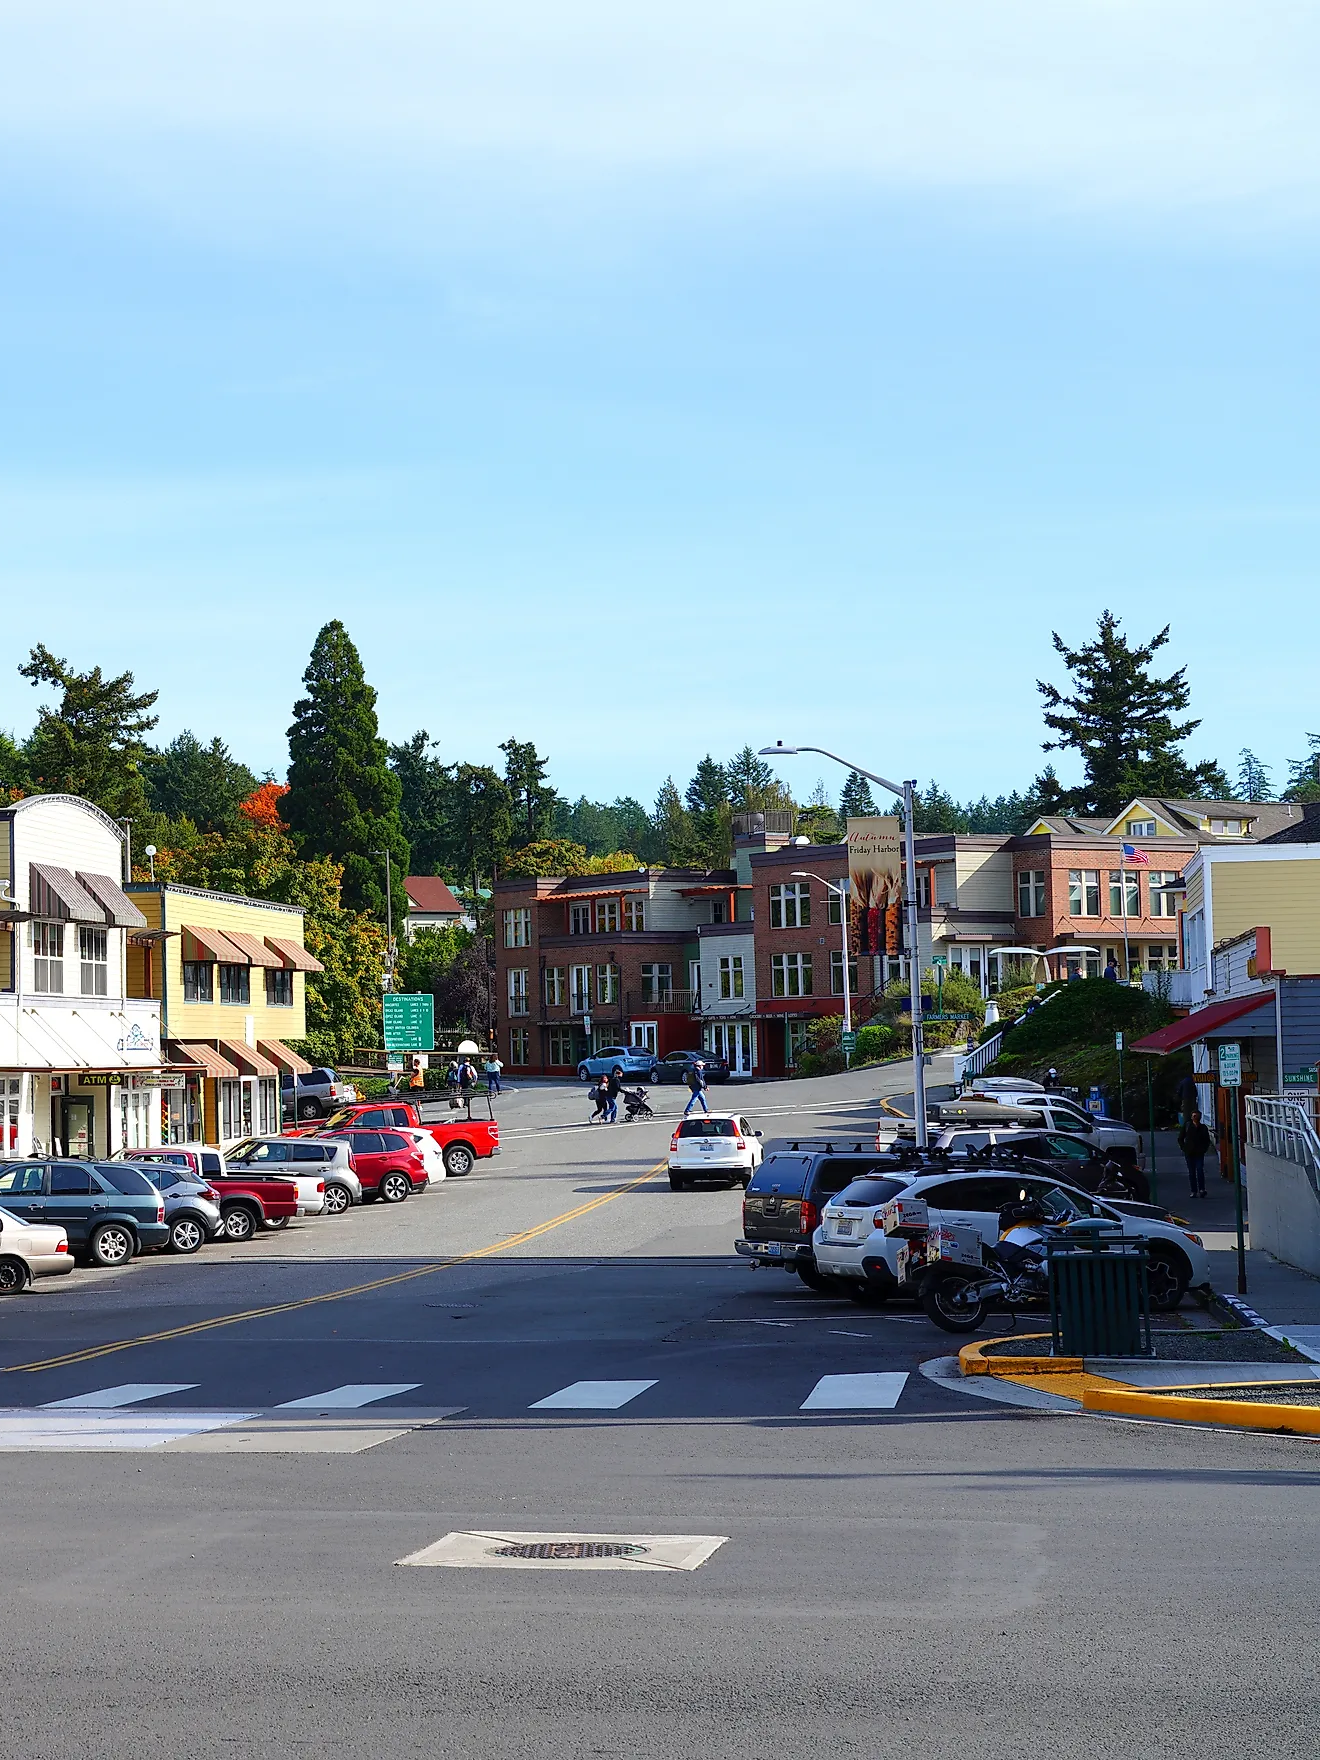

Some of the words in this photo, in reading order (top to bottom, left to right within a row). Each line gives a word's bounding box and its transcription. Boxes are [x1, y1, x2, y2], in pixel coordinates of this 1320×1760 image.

[850, 832, 896, 842] Autumn
[849, 845, 870, 855] Friday
[873, 845, 899, 853] Harbor
[1220, 1048, 1226, 1060] 2
[83, 1076, 106, 1084] ATM
[1284, 1074, 1314, 1083] SUNSHINE
[1287, 1092, 1306, 1102] ONE
